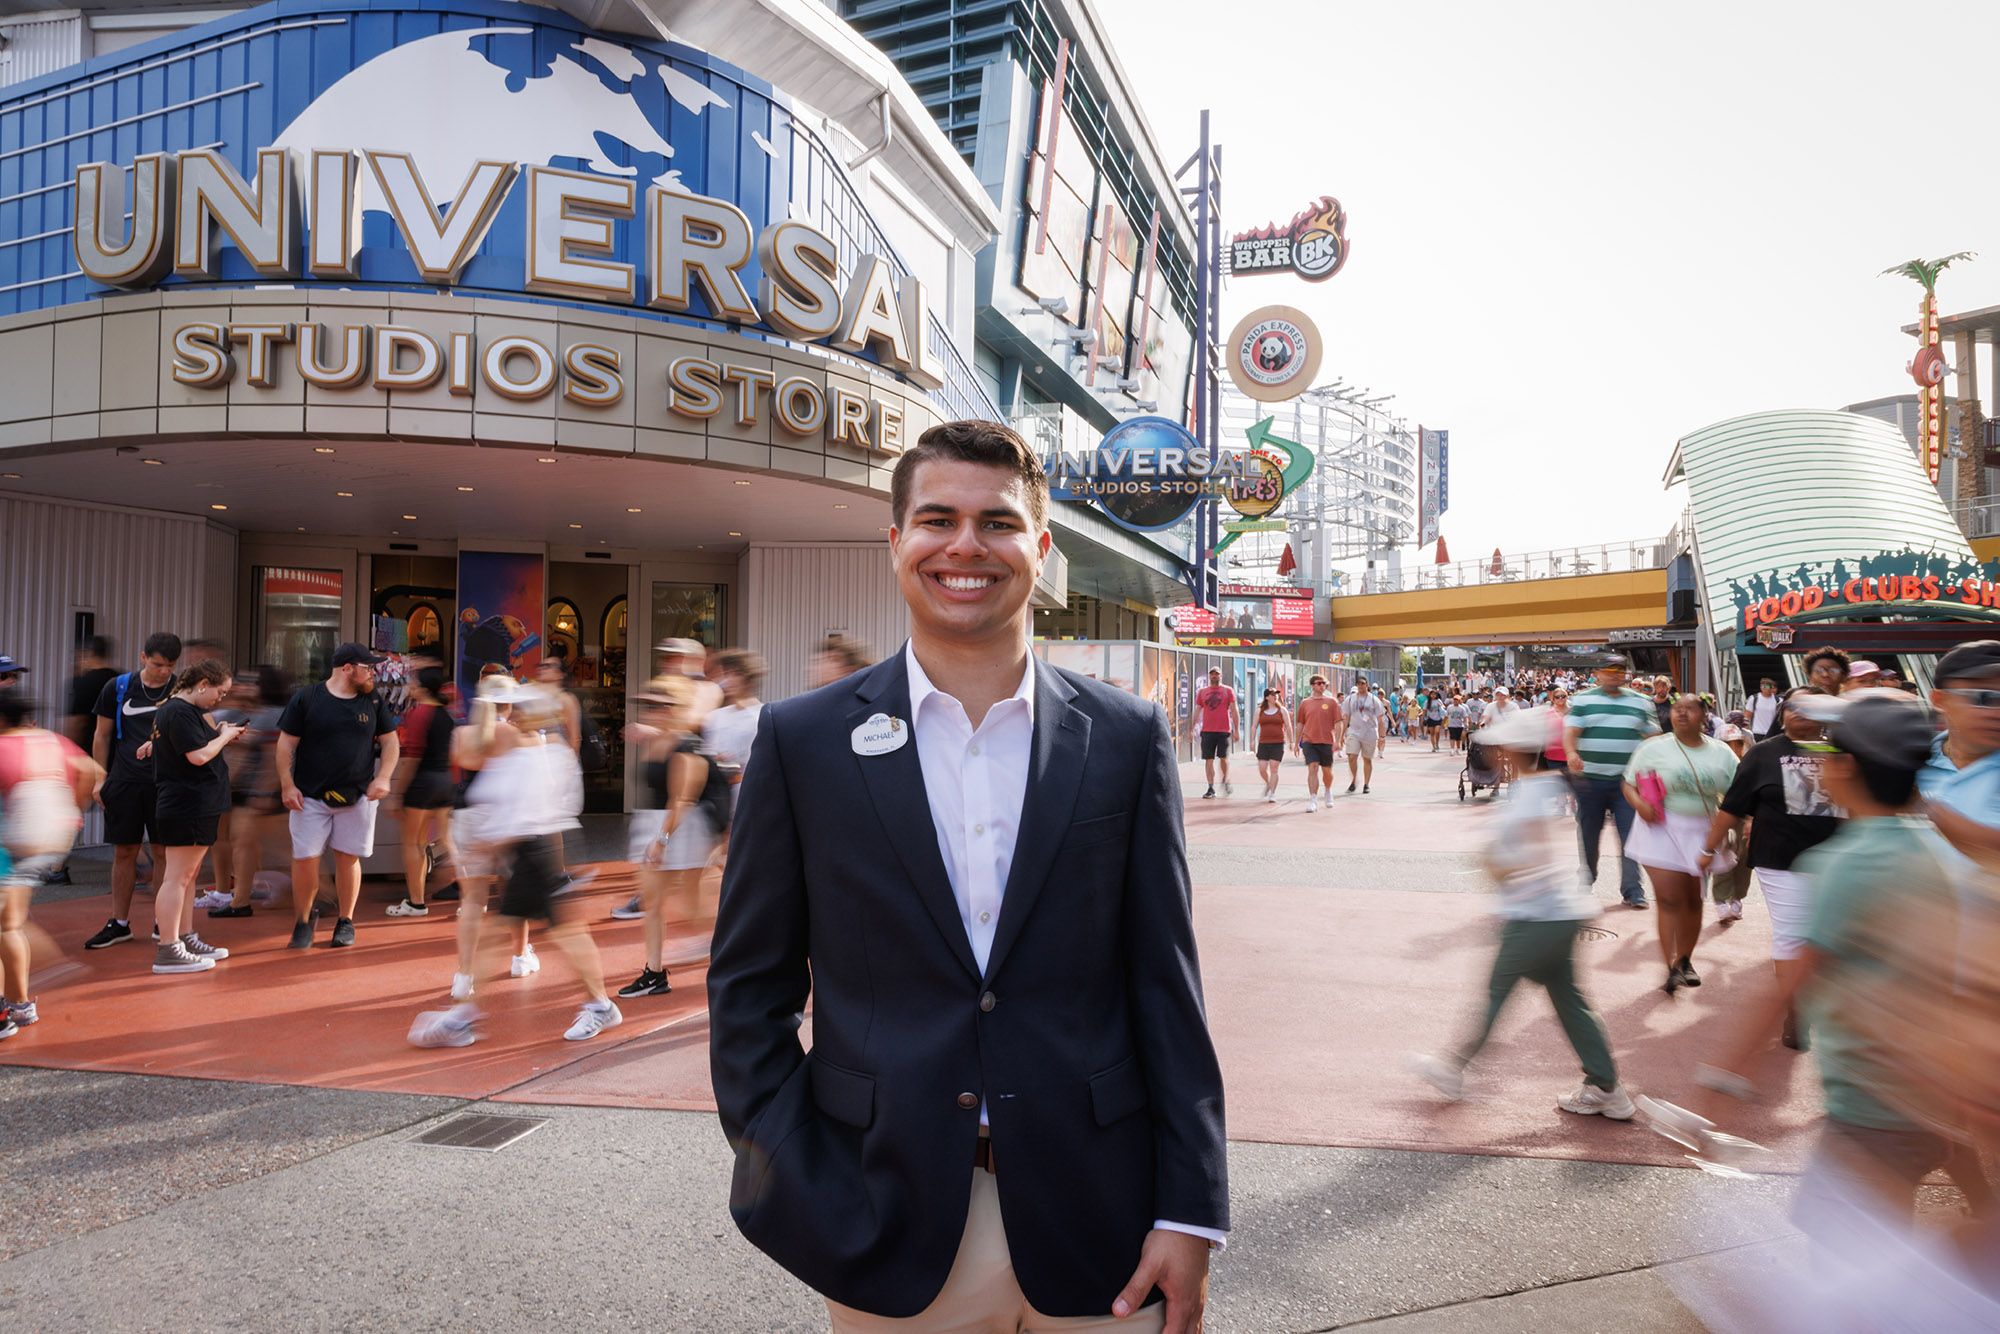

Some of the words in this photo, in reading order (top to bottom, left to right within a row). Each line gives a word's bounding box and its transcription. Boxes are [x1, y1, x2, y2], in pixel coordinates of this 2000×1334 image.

[1233, 238, 1291, 251] WHOPPER
[1234, 247, 1291, 269] BAR
[1300, 234, 1334, 266] BK
[74, 146, 943, 389] UNIVERSAL
[1242, 324, 1268, 354] PANDA
[1270, 321, 1304, 351] EXPRESS
[1243, 358, 1265, 381] GOURMET
[172, 322, 624, 406] STUDIOS
[667, 356, 903, 455] STORE
[1071, 481, 1151, 496] STUDIOS
[1160, 480, 1226, 496] STORE
[1426, 433, 1437, 539] CINEMARK
[1241, 586, 1302, 597] CINEMARK
[1744, 585, 1823, 630] FOOD
[1843, 575, 1940, 603] CLUBS
[863, 731, 895, 743] MICHAEL
